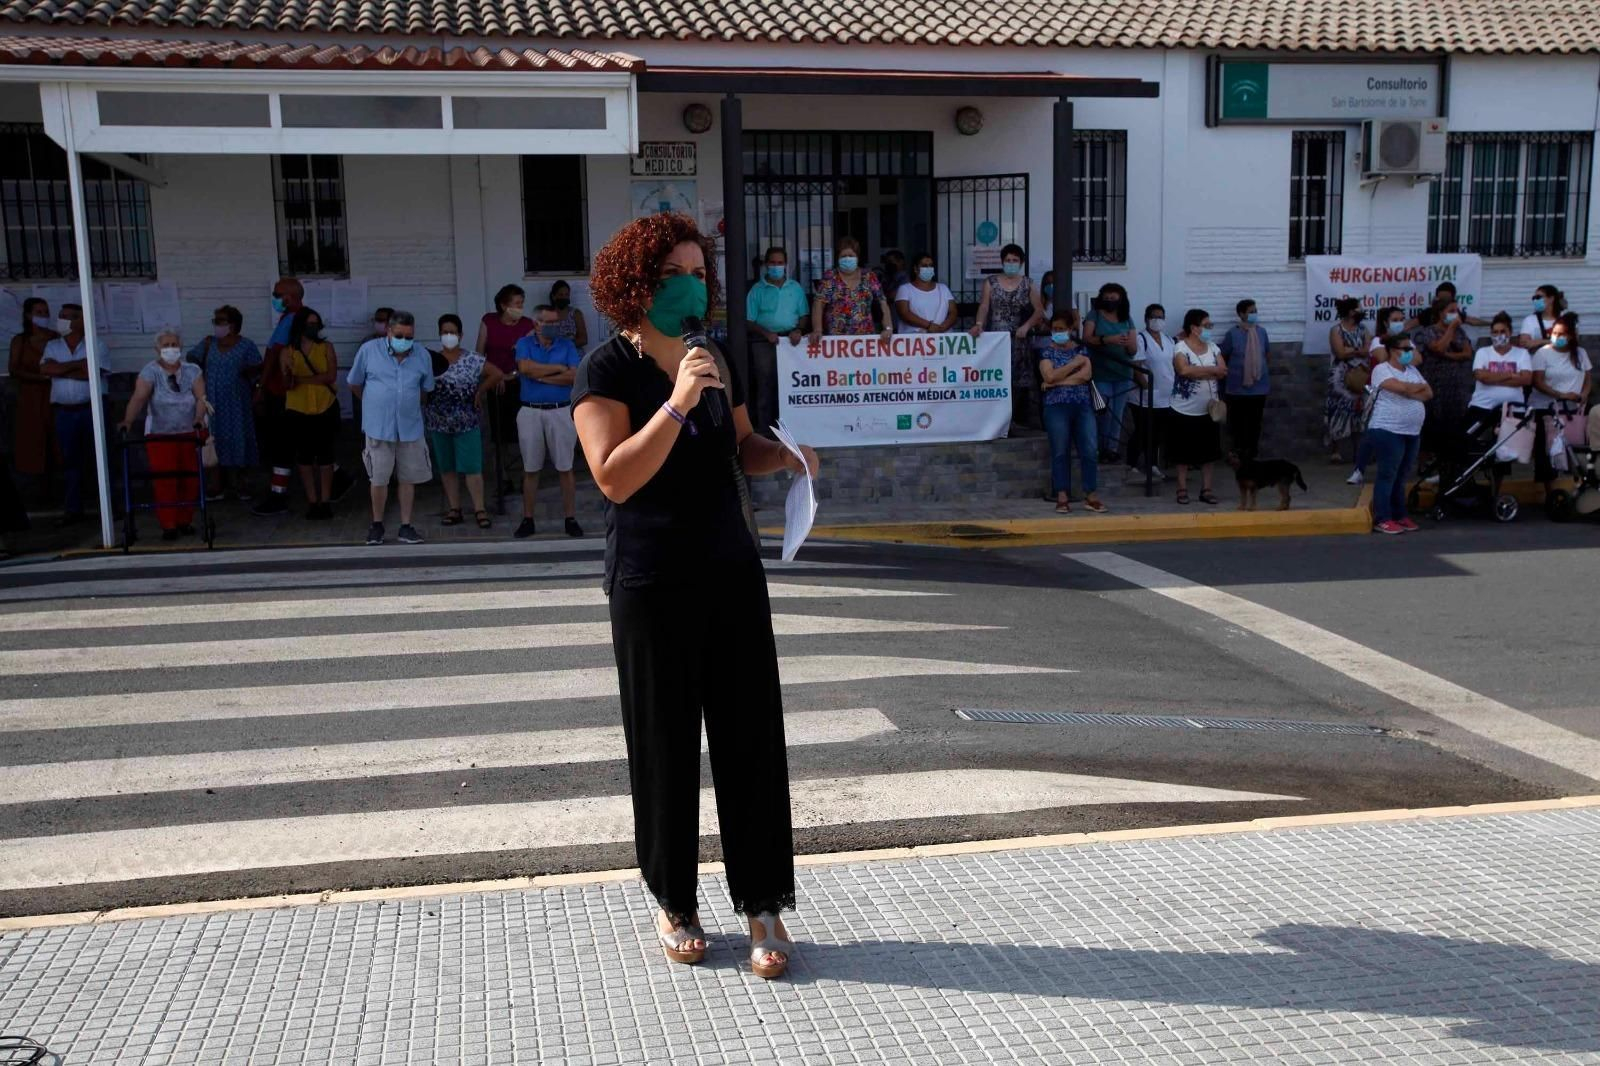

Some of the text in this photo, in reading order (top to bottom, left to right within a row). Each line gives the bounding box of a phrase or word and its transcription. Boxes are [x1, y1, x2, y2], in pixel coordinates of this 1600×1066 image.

[1367, 77, 1428, 90] Consultorio
[1332, 96, 1347, 108] San
[645, 145, 693, 159] CONSULTORIO
[645, 159, 683, 172] MEDICO
[1409, 292, 1424, 306] de
[1315, 309, 1331, 321] NO
[791, 366, 1003, 388] San Bartolomé de la Torre
[788, 387, 1008, 405] NECESITAMOS ATENCIÓN MÉDICA 24 HORAS
